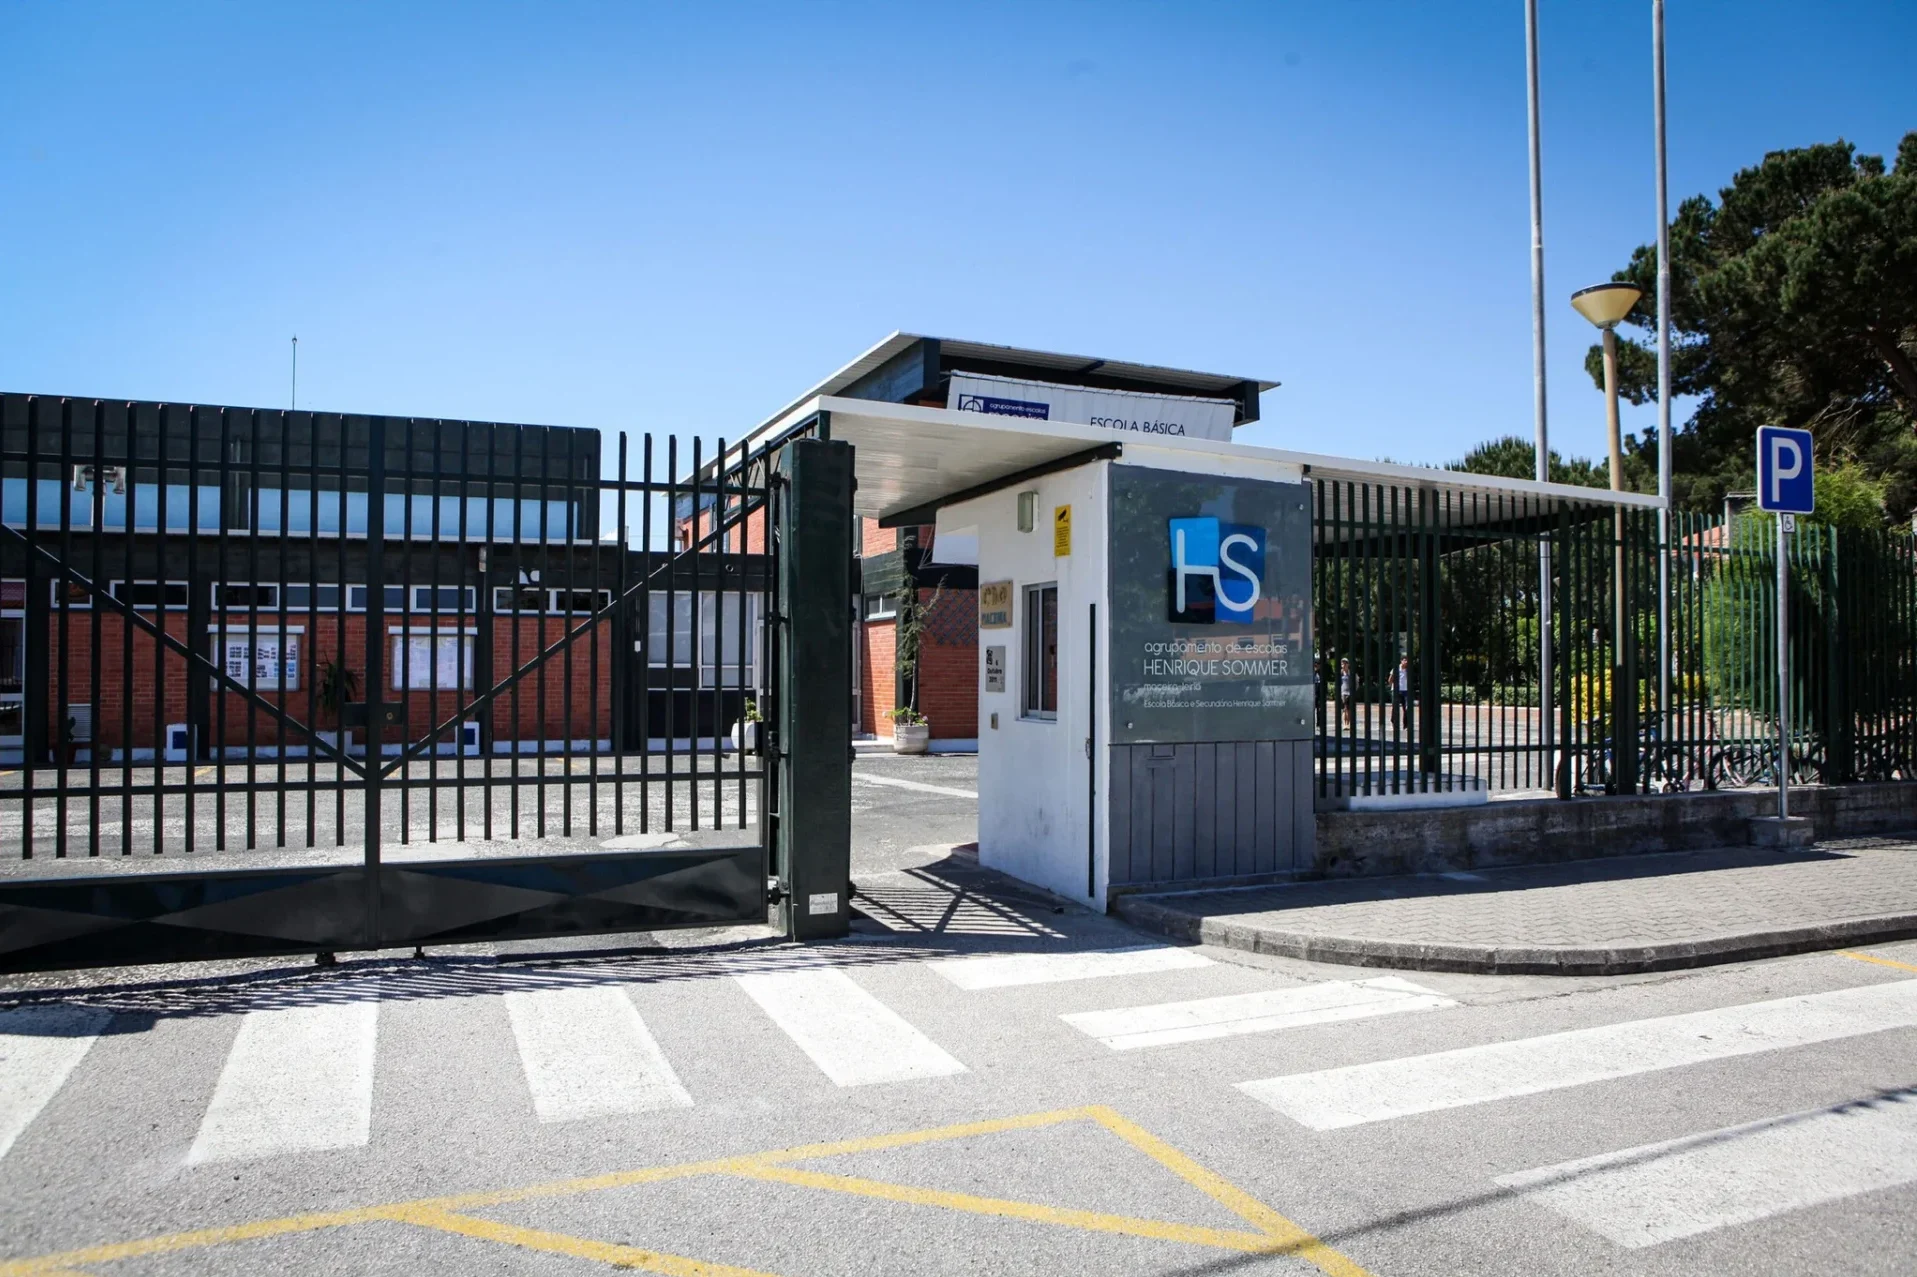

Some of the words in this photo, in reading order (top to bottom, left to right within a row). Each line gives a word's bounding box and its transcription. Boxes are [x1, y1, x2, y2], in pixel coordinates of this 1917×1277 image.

[1142, 419, 1185, 436] BÁSICA
[1771, 437, 1802, 502] P
[1176, 528, 1260, 613] HS
[1144, 641, 1222, 656] agrupamento
[1225, 643, 1241, 654] de
[1245, 643, 1288, 654] escolas
[1143, 659, 1219, 676] HENRIQUE
[1221, 659, 1288, 676] SOMMER
[1143, 699, 1167, 708] Escola
[1233, 699, 1261, 709] Henrique
